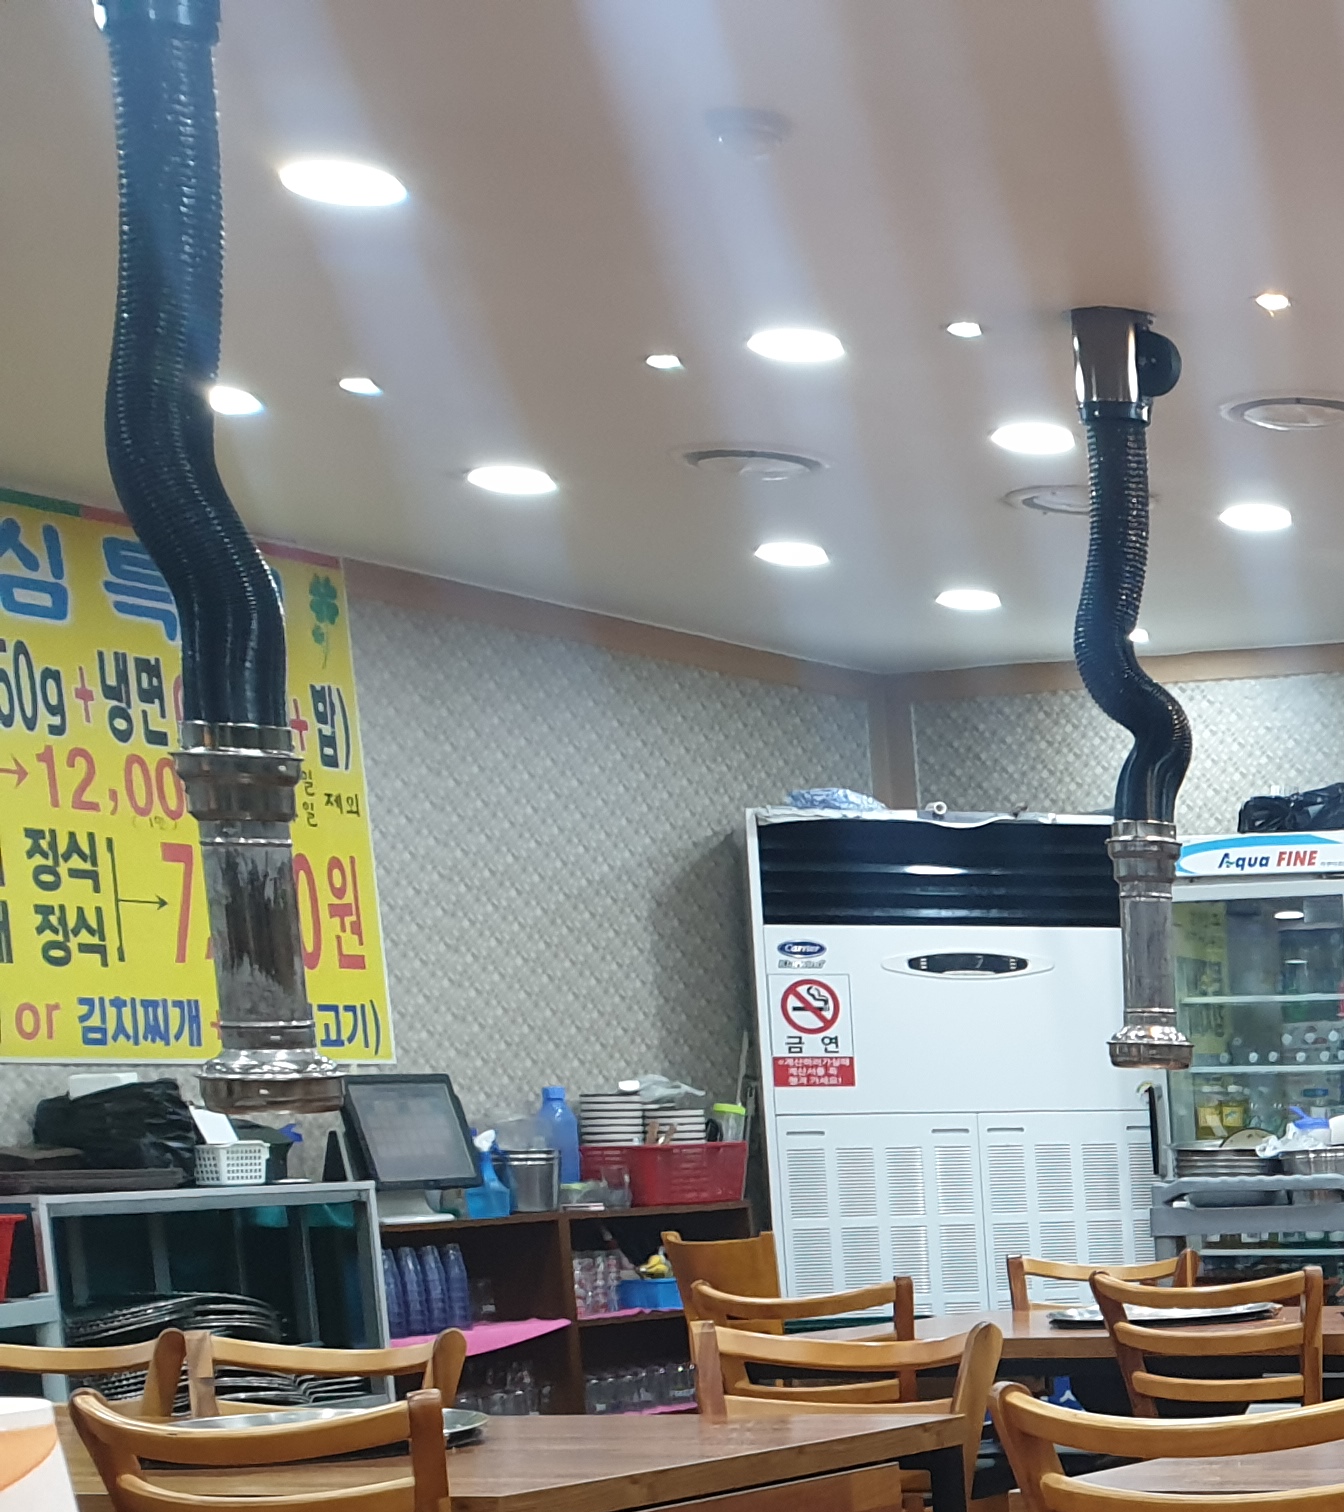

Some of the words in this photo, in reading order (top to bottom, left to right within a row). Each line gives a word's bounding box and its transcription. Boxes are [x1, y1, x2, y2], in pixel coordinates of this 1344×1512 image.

[23, 827, 101, 894] 정식
[1217, 852, 1270, 871] Aqua
[1276, 850, 1318, 868] FINE
[34, 903, 109, 967] 정식
[15, 1001, 61, 1041] or
[77, 995, 203, 1047] 김치찌개
